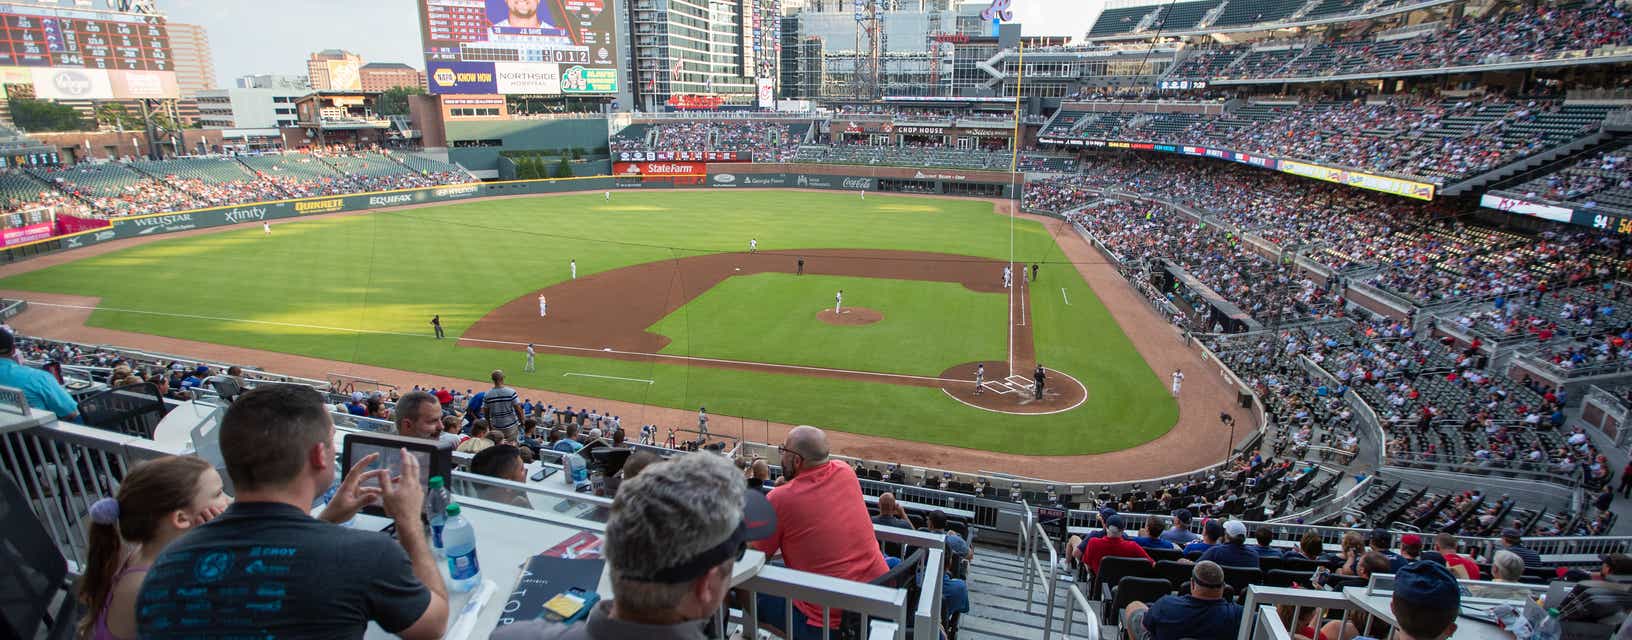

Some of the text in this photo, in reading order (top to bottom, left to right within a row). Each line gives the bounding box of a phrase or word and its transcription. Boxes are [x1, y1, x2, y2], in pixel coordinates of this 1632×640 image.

[580, 52, 587, 62] 2
[437, 73, 453, 81] NAPA
[456, 73, 477, 83] KNOW
[499, 72, 558, 81] NORTHSIDE
[295, 199, 344, 212] QUIKRETE
[369, 194, 412, 206] EQUIFAX
[134, 214, 193, 227] WELLSTAR
[225, 206, 267, 224] xfinity
